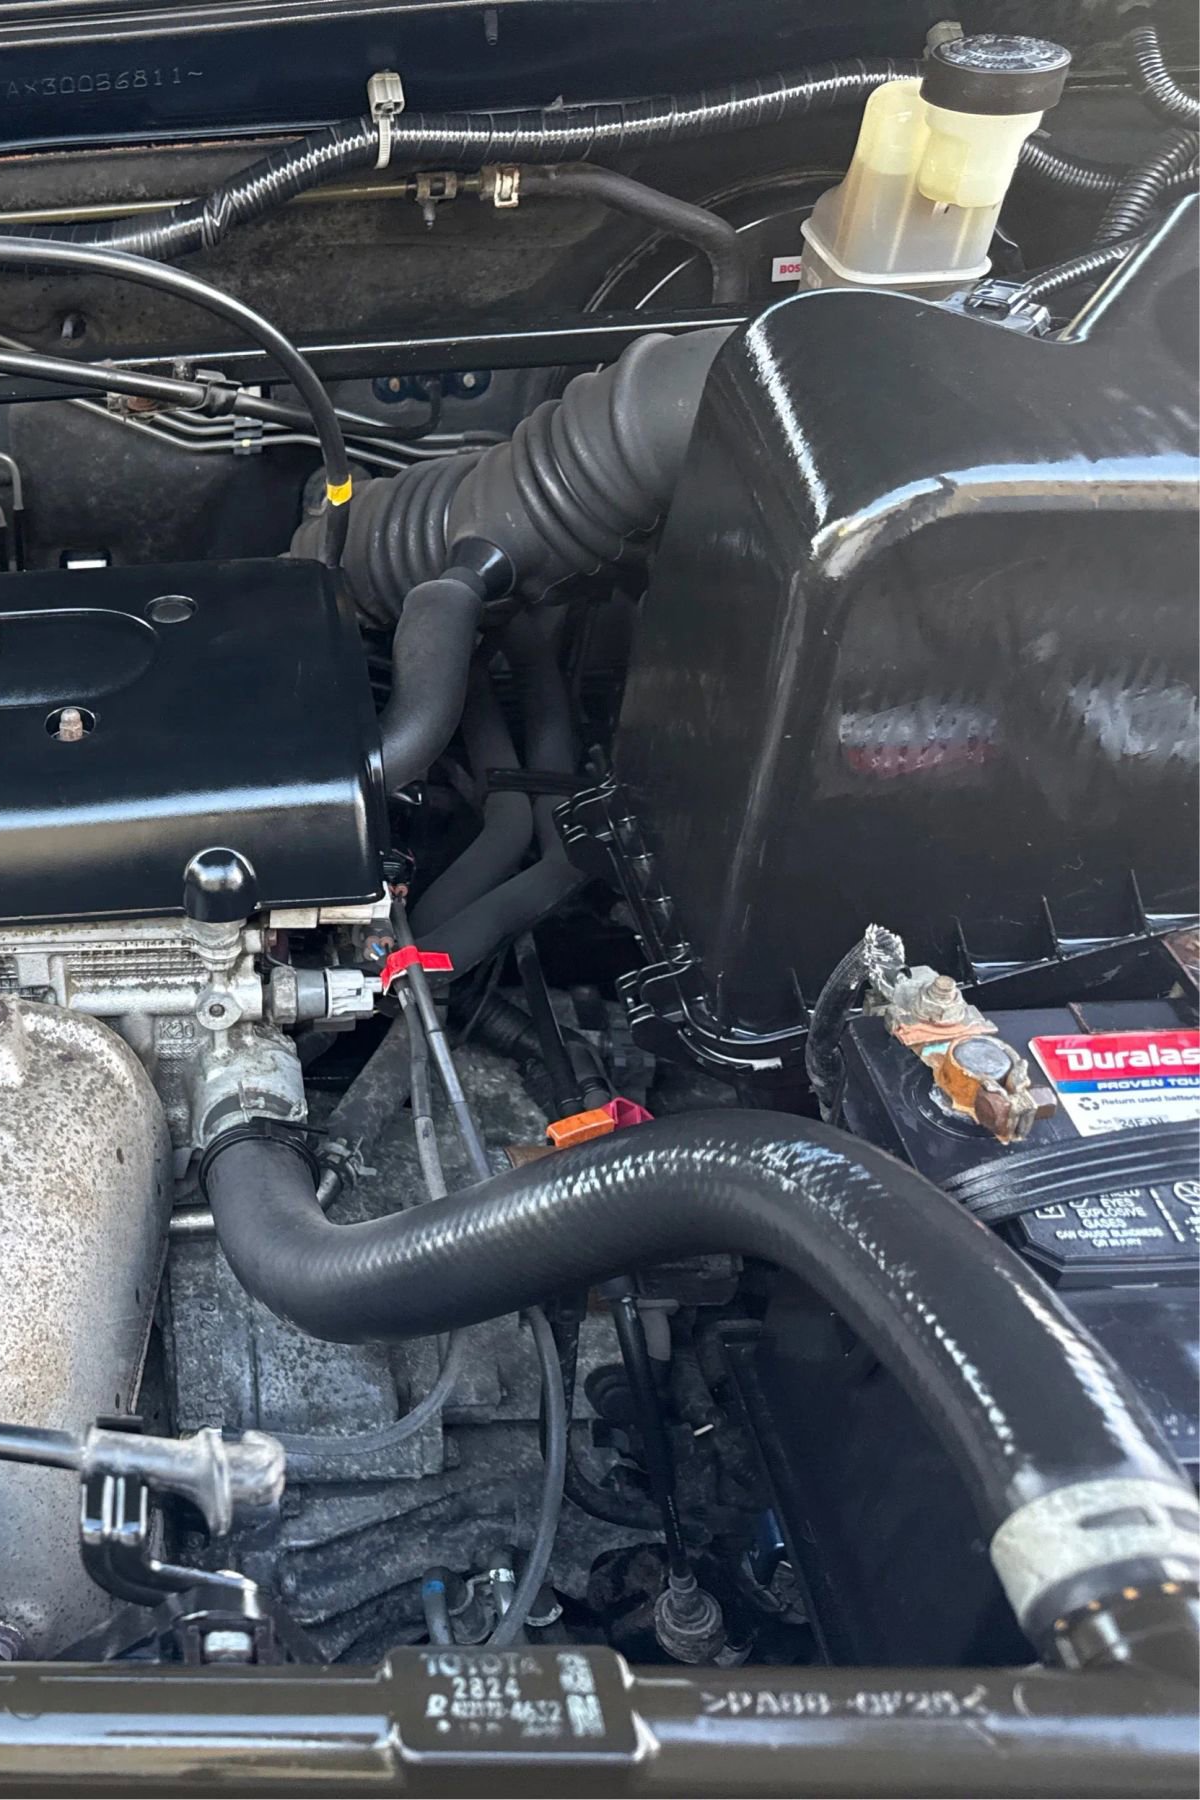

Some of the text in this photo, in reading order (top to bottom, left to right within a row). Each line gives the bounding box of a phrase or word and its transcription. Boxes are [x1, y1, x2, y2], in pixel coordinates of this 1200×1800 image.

[1096, 1078, 1165, 1091] PROVEN
[1100, 1198, 1135, 1209] EYES
[1076, 1206, 1147, 1218] EXPLOSIVE
[1082, 1218, 1127, 1229] GASES
[420, 1652, 544, 1678] TOYOTA
